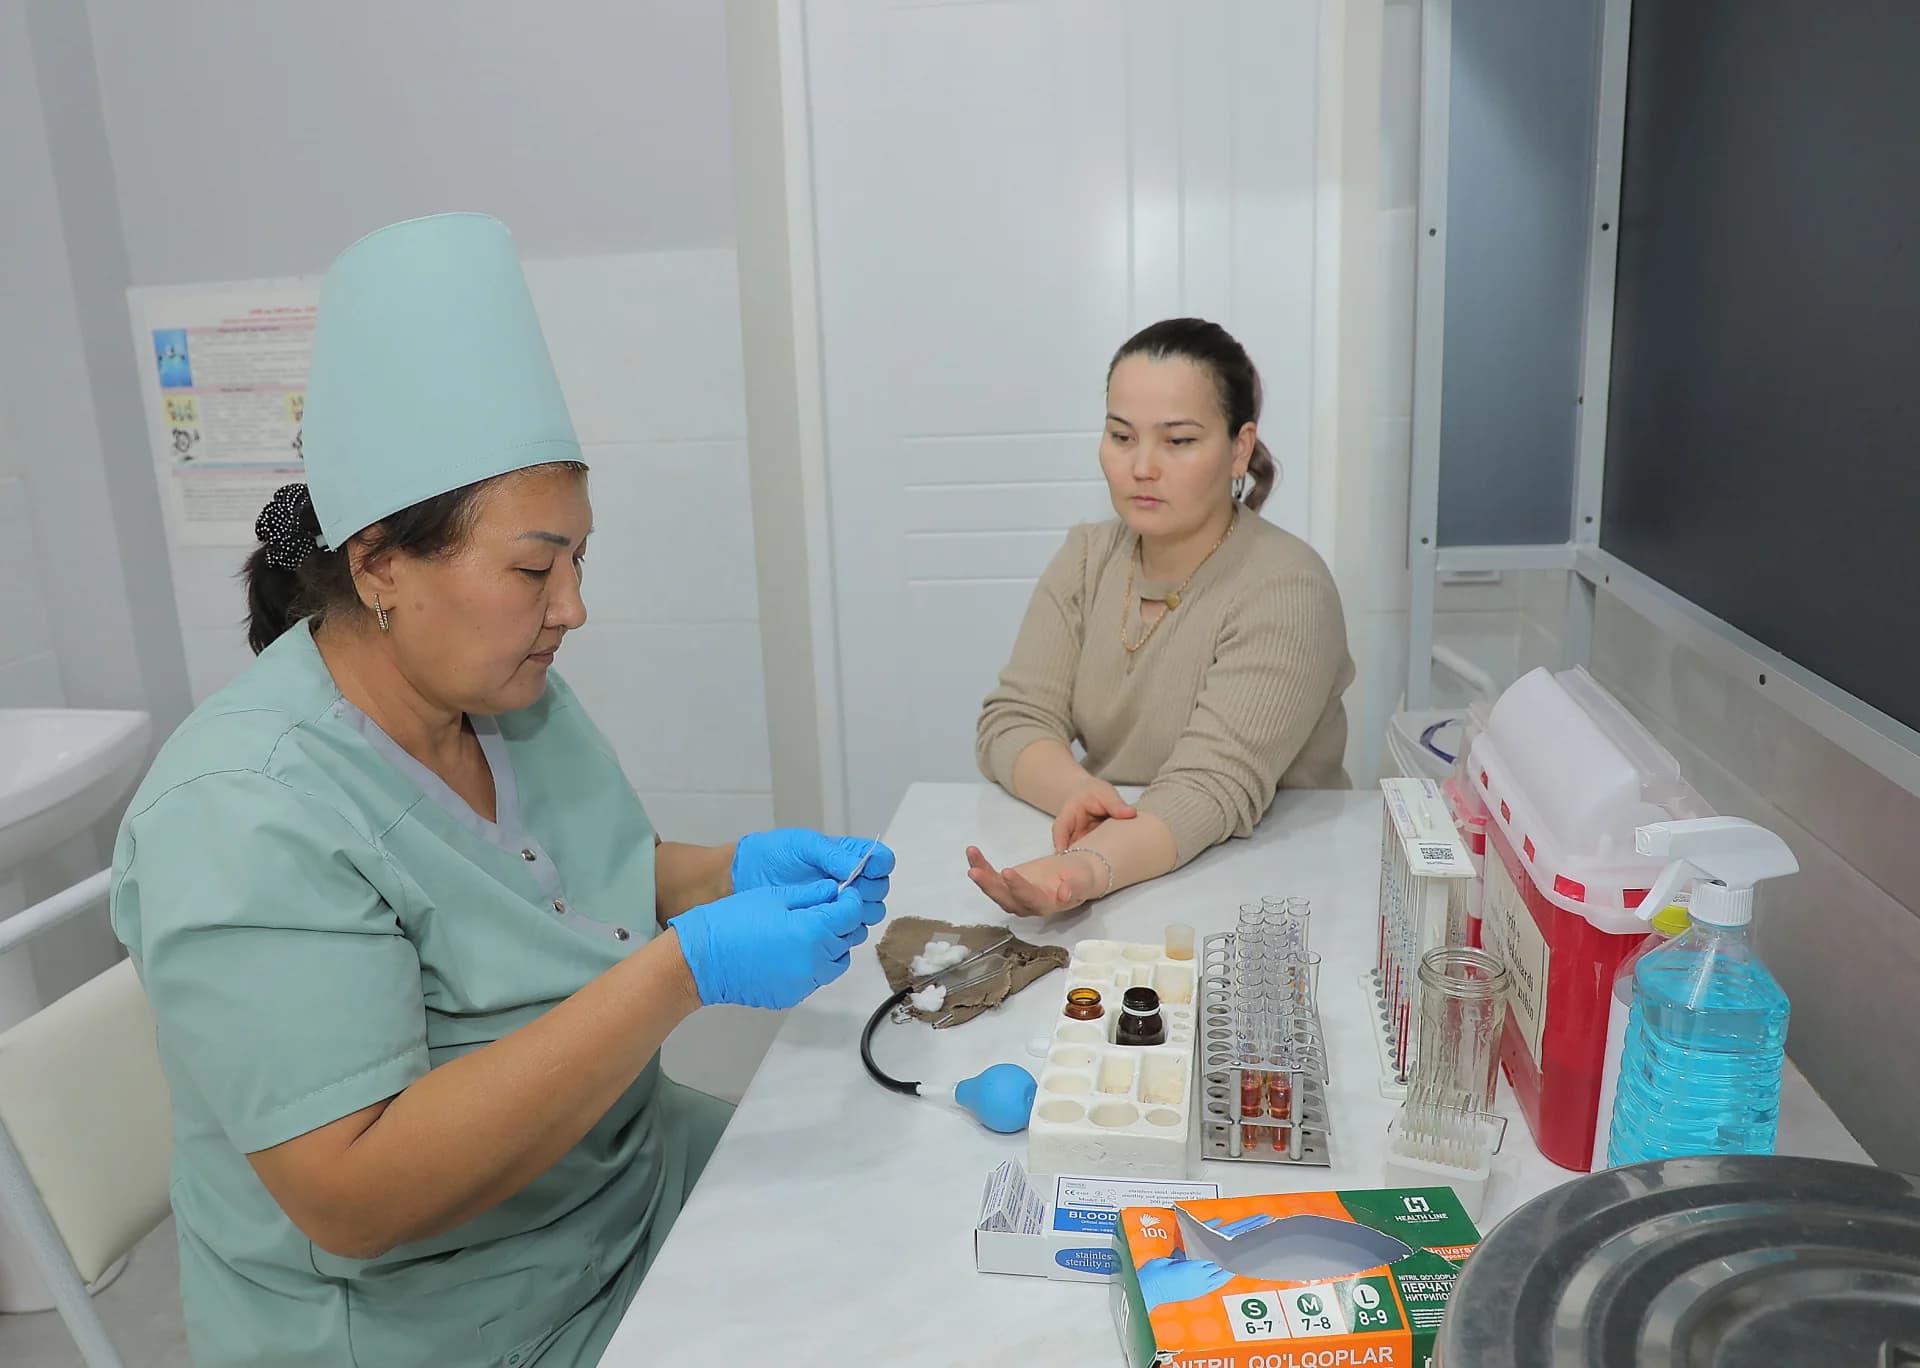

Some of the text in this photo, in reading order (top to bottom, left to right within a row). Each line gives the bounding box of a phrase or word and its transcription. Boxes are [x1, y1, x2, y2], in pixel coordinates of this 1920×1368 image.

[1069, 1211, 1117, 1221] BLOOD
[1140, 1227, 1168, 1240] 100
[1075, 1251, 1112, 1259] stainles
[1065, 1259, 1100, 1269] sterility
[1420, 1273, 1459, 1281] QO'LQOPLA
[1361, 1290, 1374, 1304] L
[1404, 1292, 1450, 1302] НИТРИЛО
[1247, 1302, 1261, 1315] S
[1302, 1297, 1319, 1312] M
[1302, 1317, 1331, 1331] 7-8
[1358, 1310, 1388, 1325] 8-9
[1245, 1320, 1273, 1334] 6-7
[1248, 1347, 1393, 1368] QO'LQOPLAR
